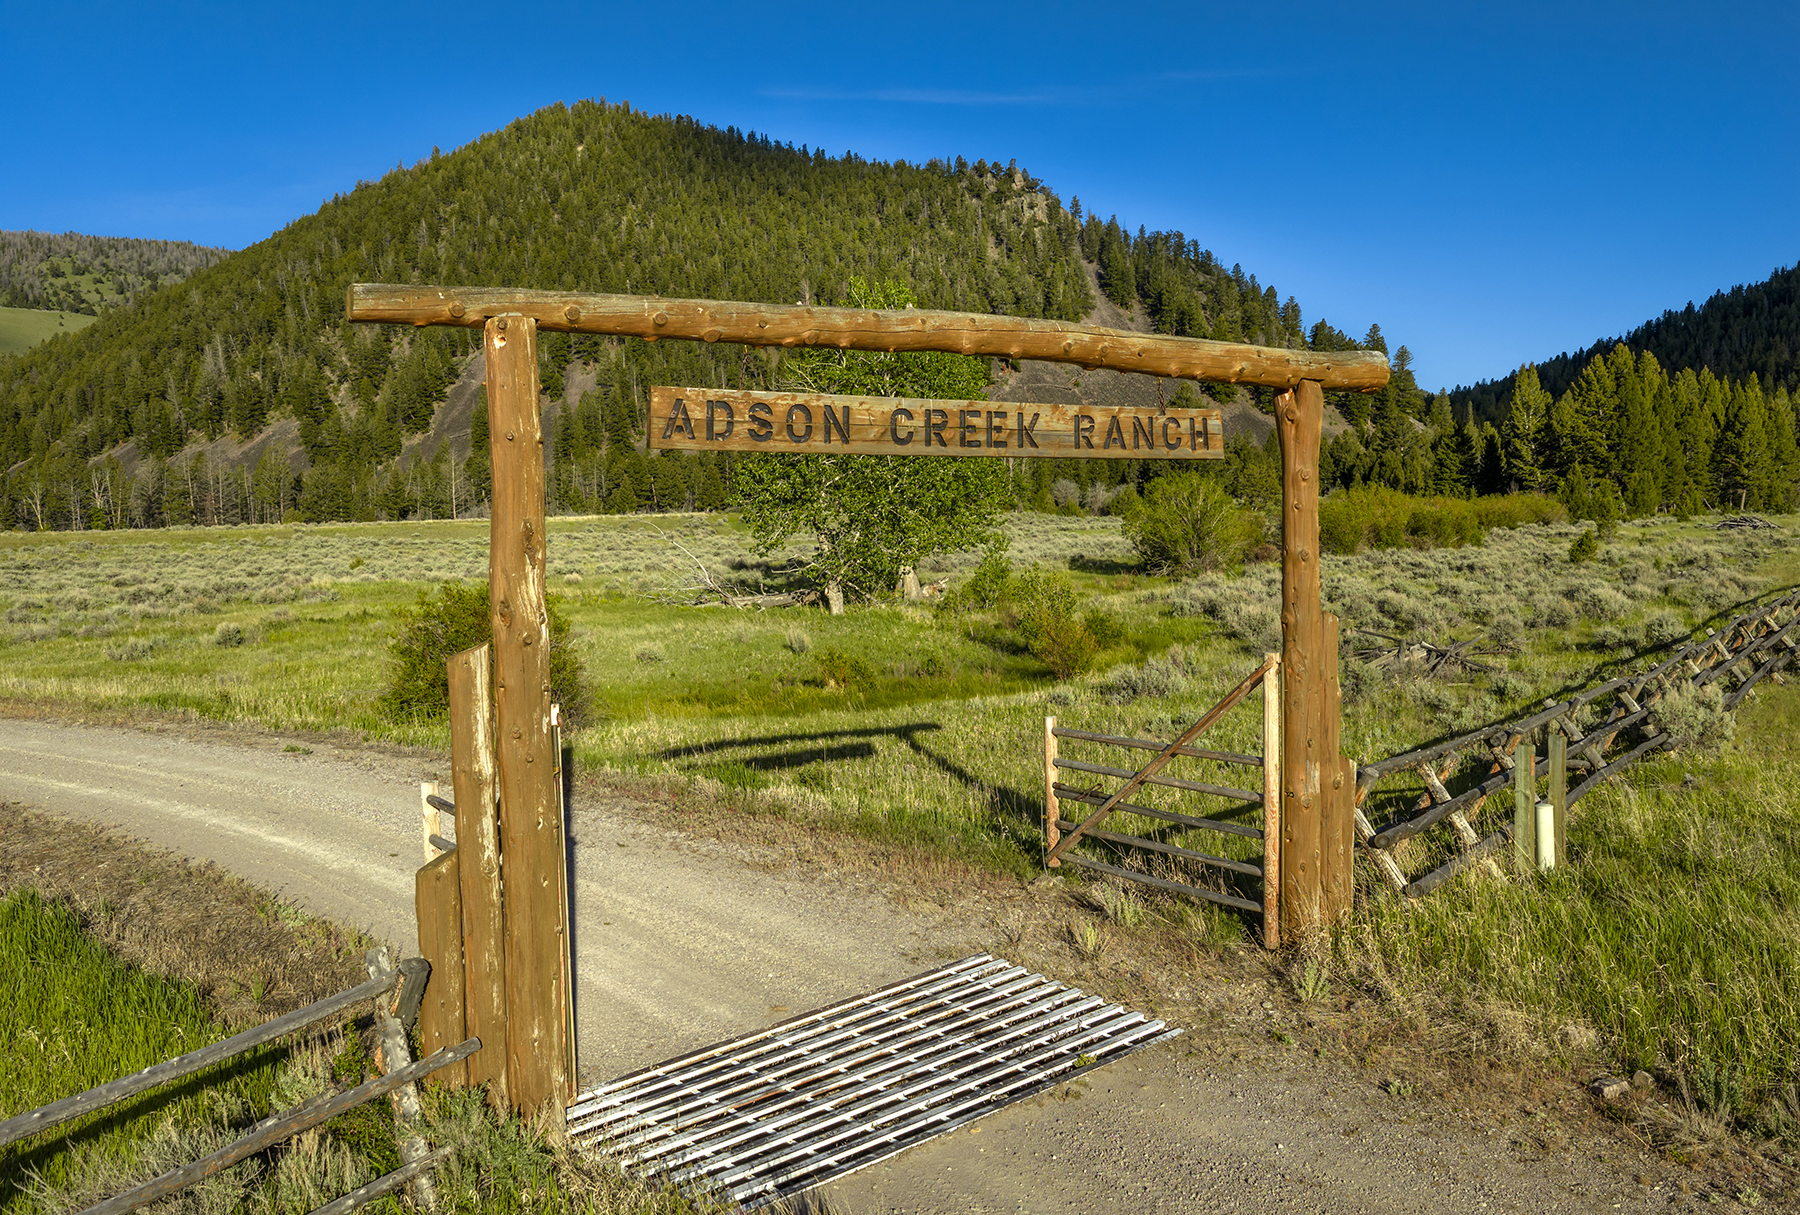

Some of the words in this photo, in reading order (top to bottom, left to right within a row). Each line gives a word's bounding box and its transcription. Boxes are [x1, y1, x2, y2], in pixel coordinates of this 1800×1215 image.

[662, 398, 850, 444] ADSON
[890, 407, 1040, 449] CREEK
[1074, 414, 1209, 450] RANCH
